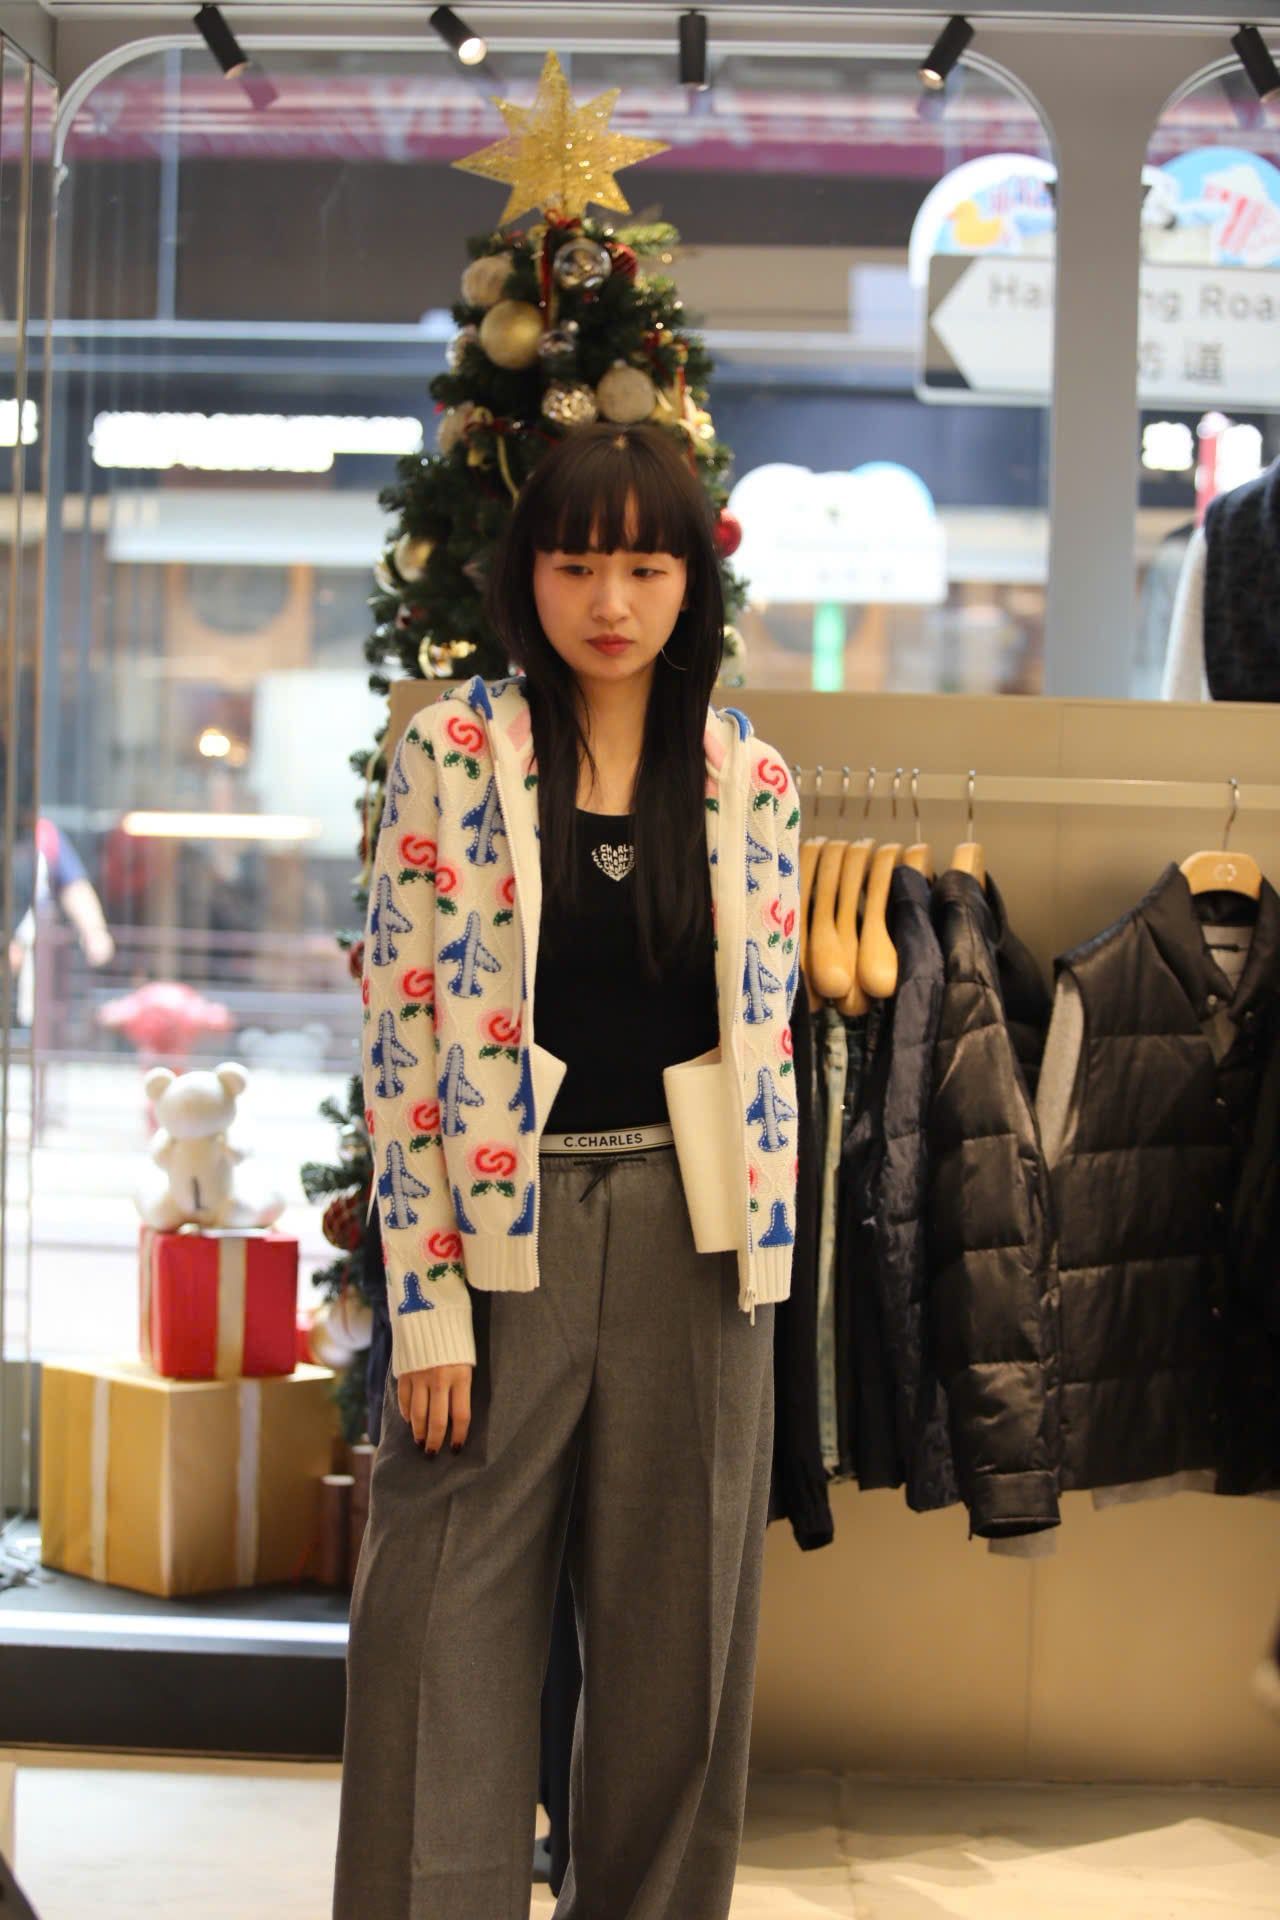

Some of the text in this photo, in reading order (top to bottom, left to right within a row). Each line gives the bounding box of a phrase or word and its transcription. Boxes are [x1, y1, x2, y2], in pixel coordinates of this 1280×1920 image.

[988, 273, 1053, 309] Ha
[1200, 283, 1280, 322] Roa
[564, 1133, 643, 1147] C.CHARLES
